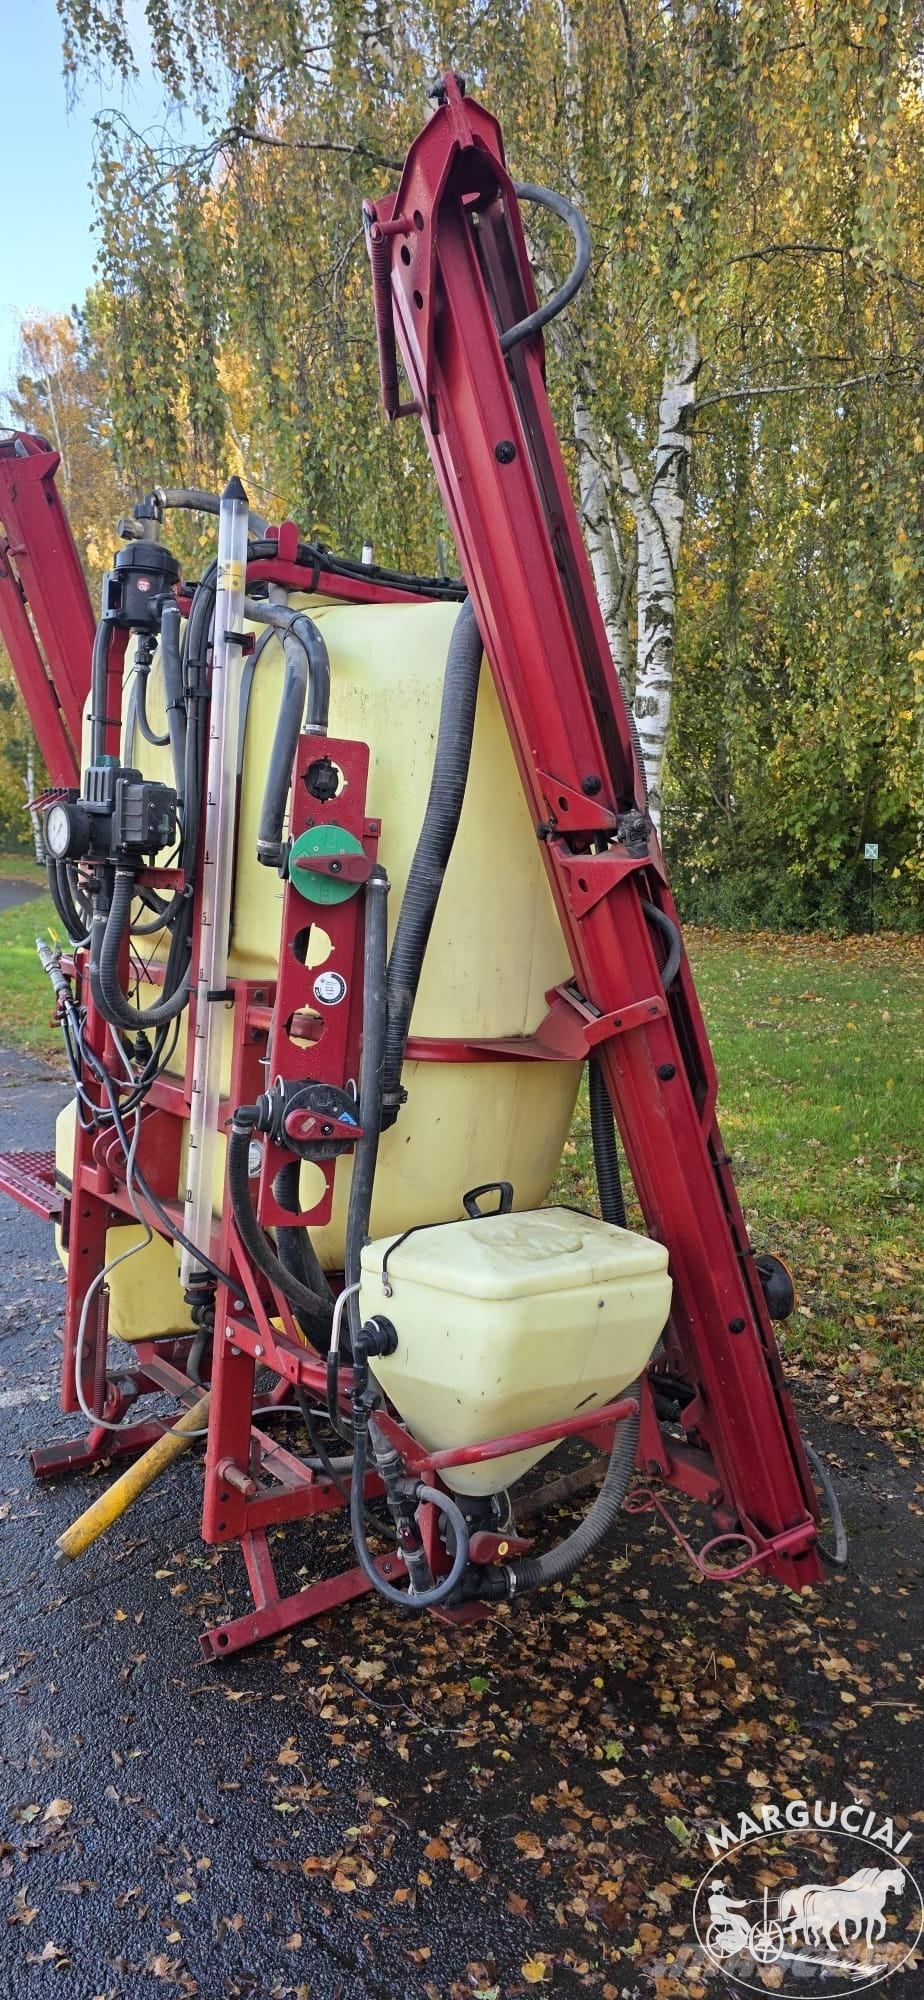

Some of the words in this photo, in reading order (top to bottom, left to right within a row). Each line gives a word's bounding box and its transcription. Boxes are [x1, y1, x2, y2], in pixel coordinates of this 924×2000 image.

[208, 791, 212, 803] 3
[205, 850, 210, 862] 4
[202, 912, 207, 922] 5
[200, 968, 204, 979] 6
